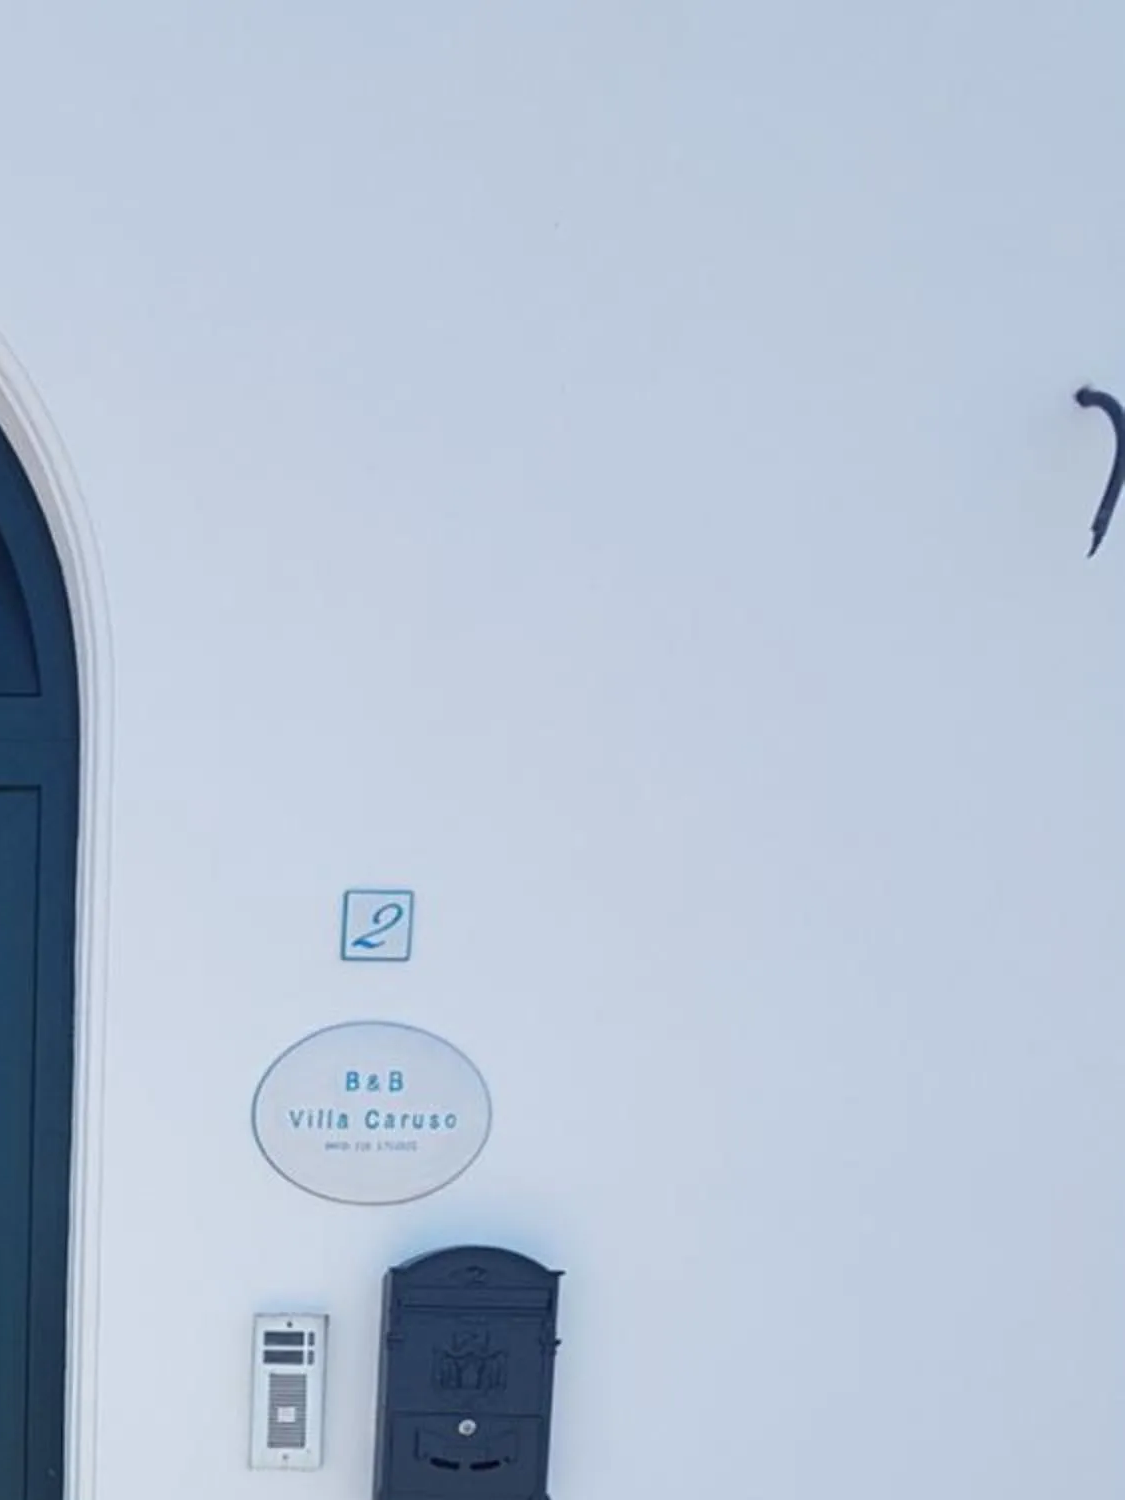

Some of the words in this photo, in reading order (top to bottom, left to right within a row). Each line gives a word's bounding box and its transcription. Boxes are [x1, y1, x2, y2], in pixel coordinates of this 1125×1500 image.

[350, 902, 404, 950] 2
[288, 1109, 349, 1130] Villa
[364, 1108, 458, 1130] Caruso
